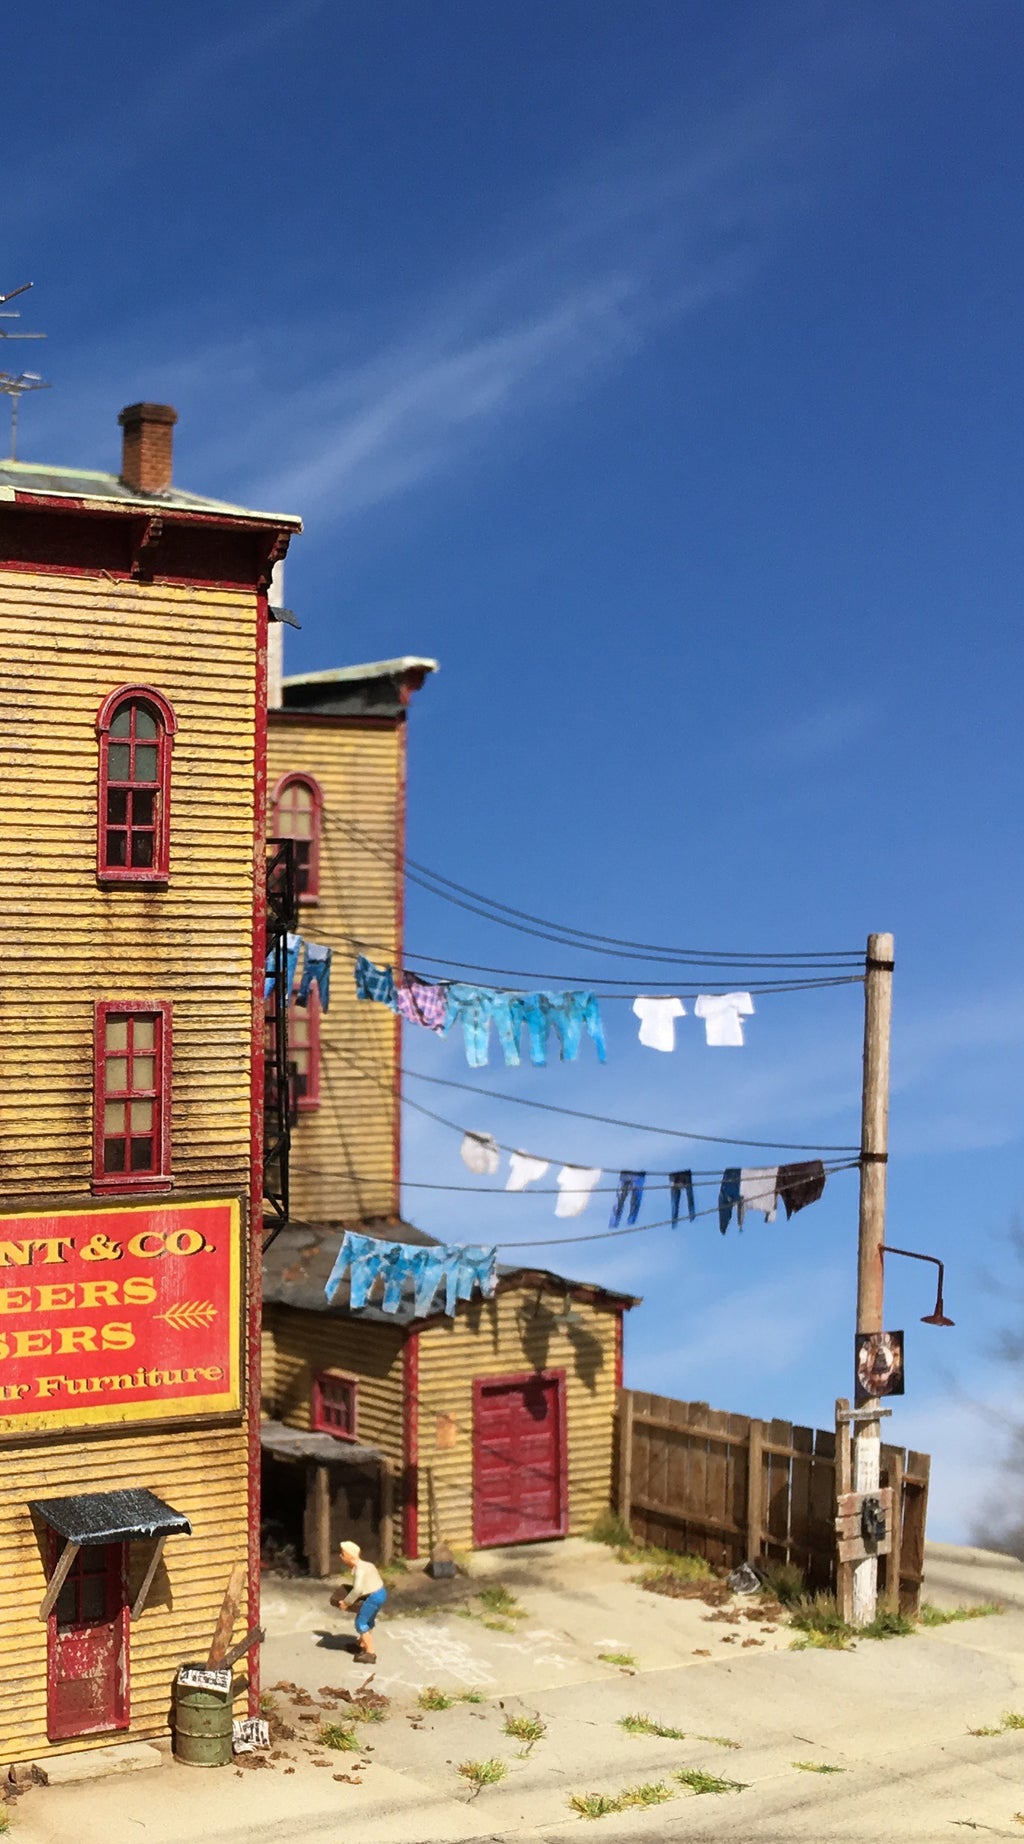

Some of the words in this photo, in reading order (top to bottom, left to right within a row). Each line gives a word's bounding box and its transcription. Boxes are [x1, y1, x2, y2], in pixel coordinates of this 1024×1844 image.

[79, 1233, 123, 1262] &
[128, 1228, 216, 1259] CO.
[34, 1366, 224, 1398] Furniture
